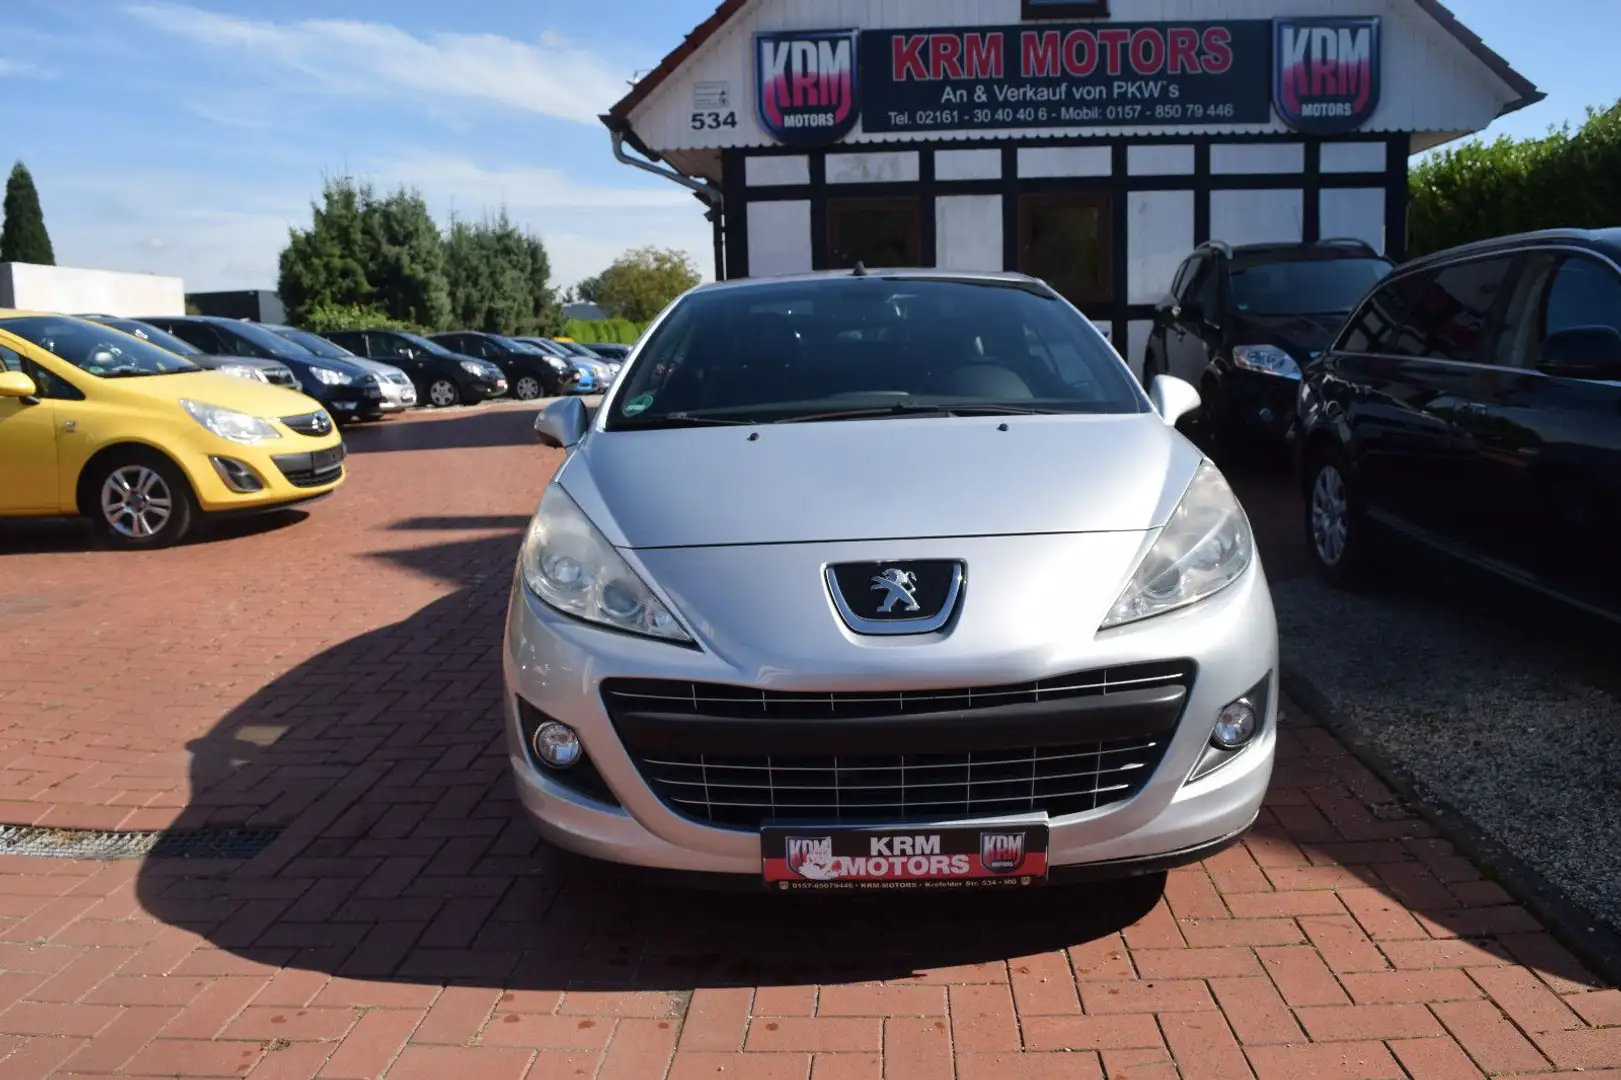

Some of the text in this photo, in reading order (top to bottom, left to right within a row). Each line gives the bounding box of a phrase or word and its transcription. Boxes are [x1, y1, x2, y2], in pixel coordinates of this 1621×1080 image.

[891, 26, 1233, 82] KRM MOTORS
[1282, 28, 1370, 113] KRM
[761, 39, 852, 126] KRM
[941, 85, 967, 103] An
[974, 84, 987, 102] &
[993, 81, 1068, 102] Verkauf
[1072, 85, 1106, 100] von
[691, 111, 737, 130] 534
[784, 113, 834, 128] MOTORS
[888, 111, 912, 125] Tel.
[916, 110, 959, 124] 02161
[974, 109, 991, 123] 30
[994, 108, 1013, 122] 40
[1016, 107, 1034, 121] 40
[1038, 107, 1047, 121] 6
[1061, 106, 1102, 120] Mobil:
[1106, 105, 1141, 119] 0157
[1155, 104, 1181, 118] 850
[1186, 104, 1204, 117] 79
[1206, 103, 1234, 117] 446
[1301, 103, 1352, 117] MOTORS
[870, 835, 941, 855] KRM
[839, 855, 970, 876] MOTORS
